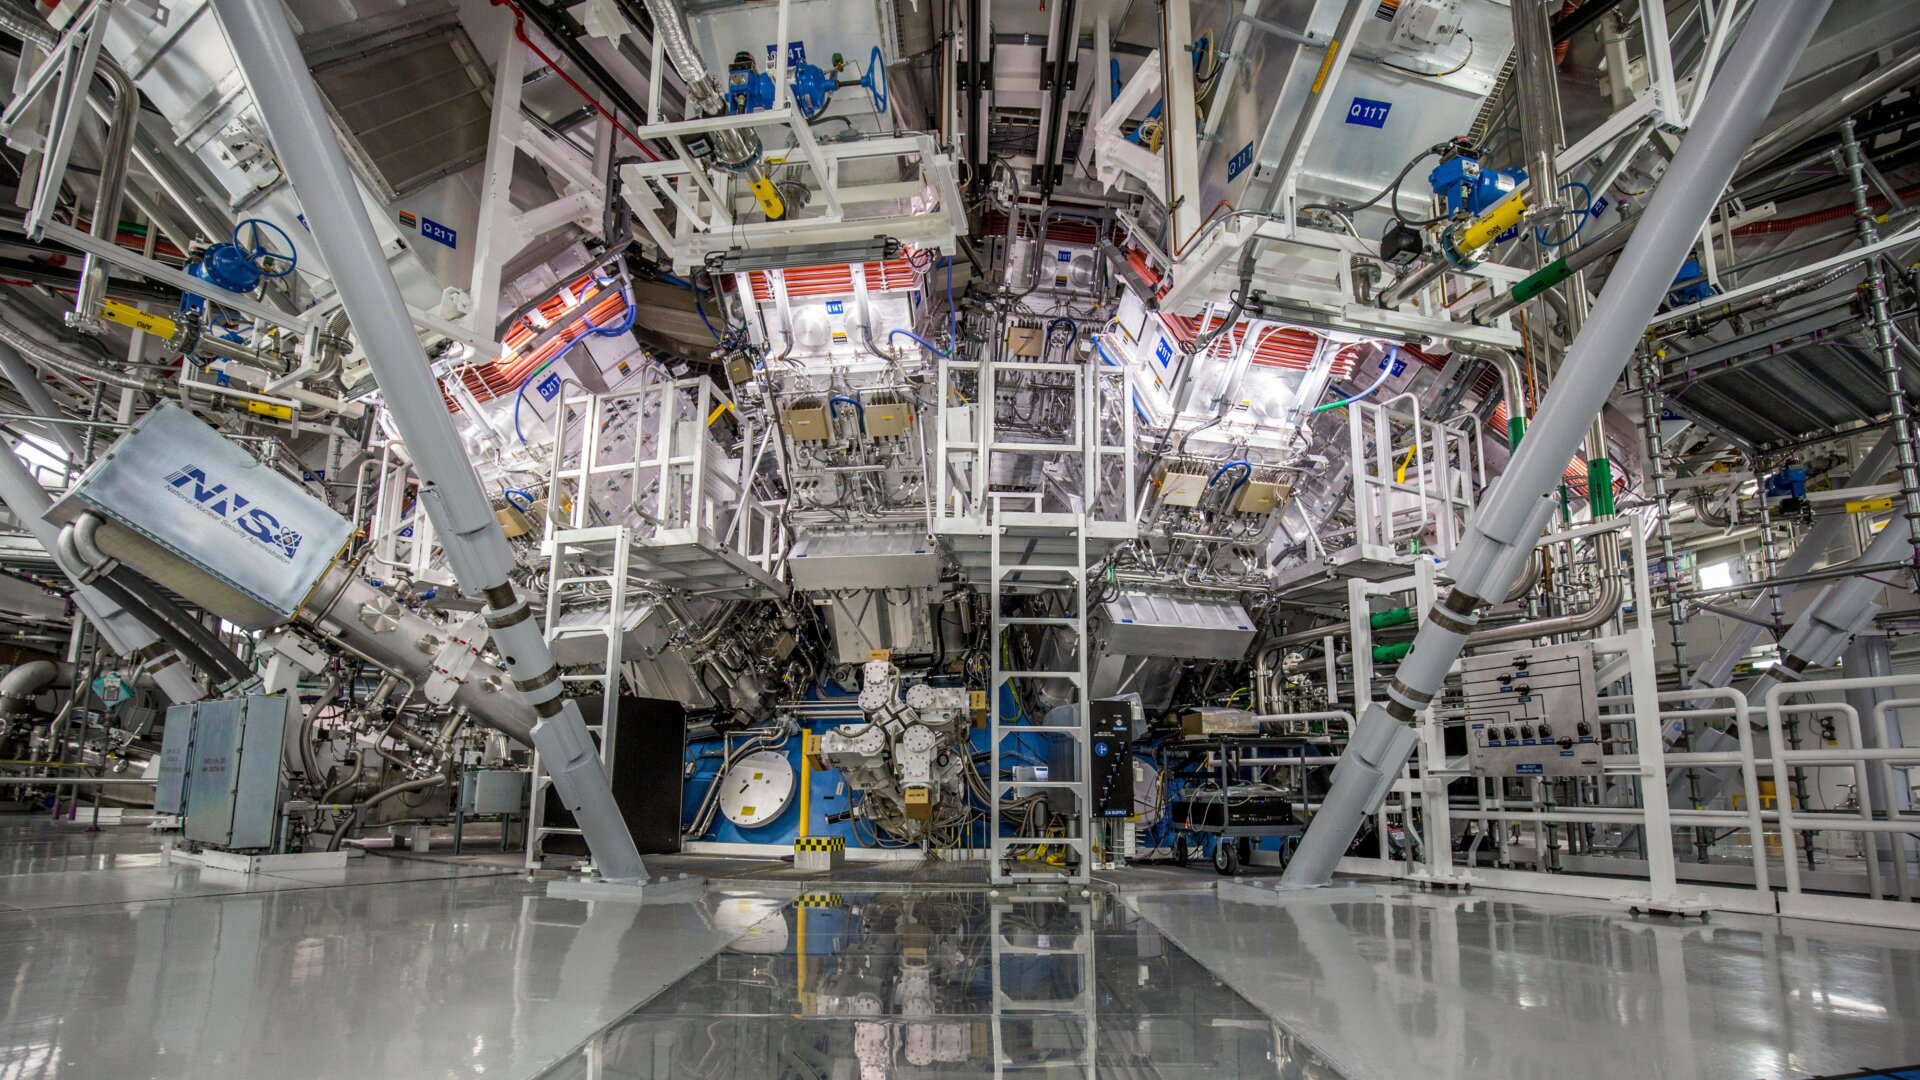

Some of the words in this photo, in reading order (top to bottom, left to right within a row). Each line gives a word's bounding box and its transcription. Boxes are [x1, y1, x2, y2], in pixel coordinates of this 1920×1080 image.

[1351, 104, 1362, 117] Q
[1378, 108, 1388, 120] T
[1229, 162, 1236, 175] Q
[1247, 145, 1253, 159] T
[423, 222, 432, 234] Q
[434, 227, 445, 239] 21
[447, 232, 455, 242] T
[1486, 224, 1502, 237] ARG
[136, 320, 152, 331] ARG
[540, 387, 550, 397] Q
[546, 381, 557, 392] 21
[552, 376, 560, 385] T
[164, 484, 195, 505] National
[193, 503, 221, 521] Nuclear
[220, 519, 248, 538] Security
[247, 535, 291, 566] Administration
